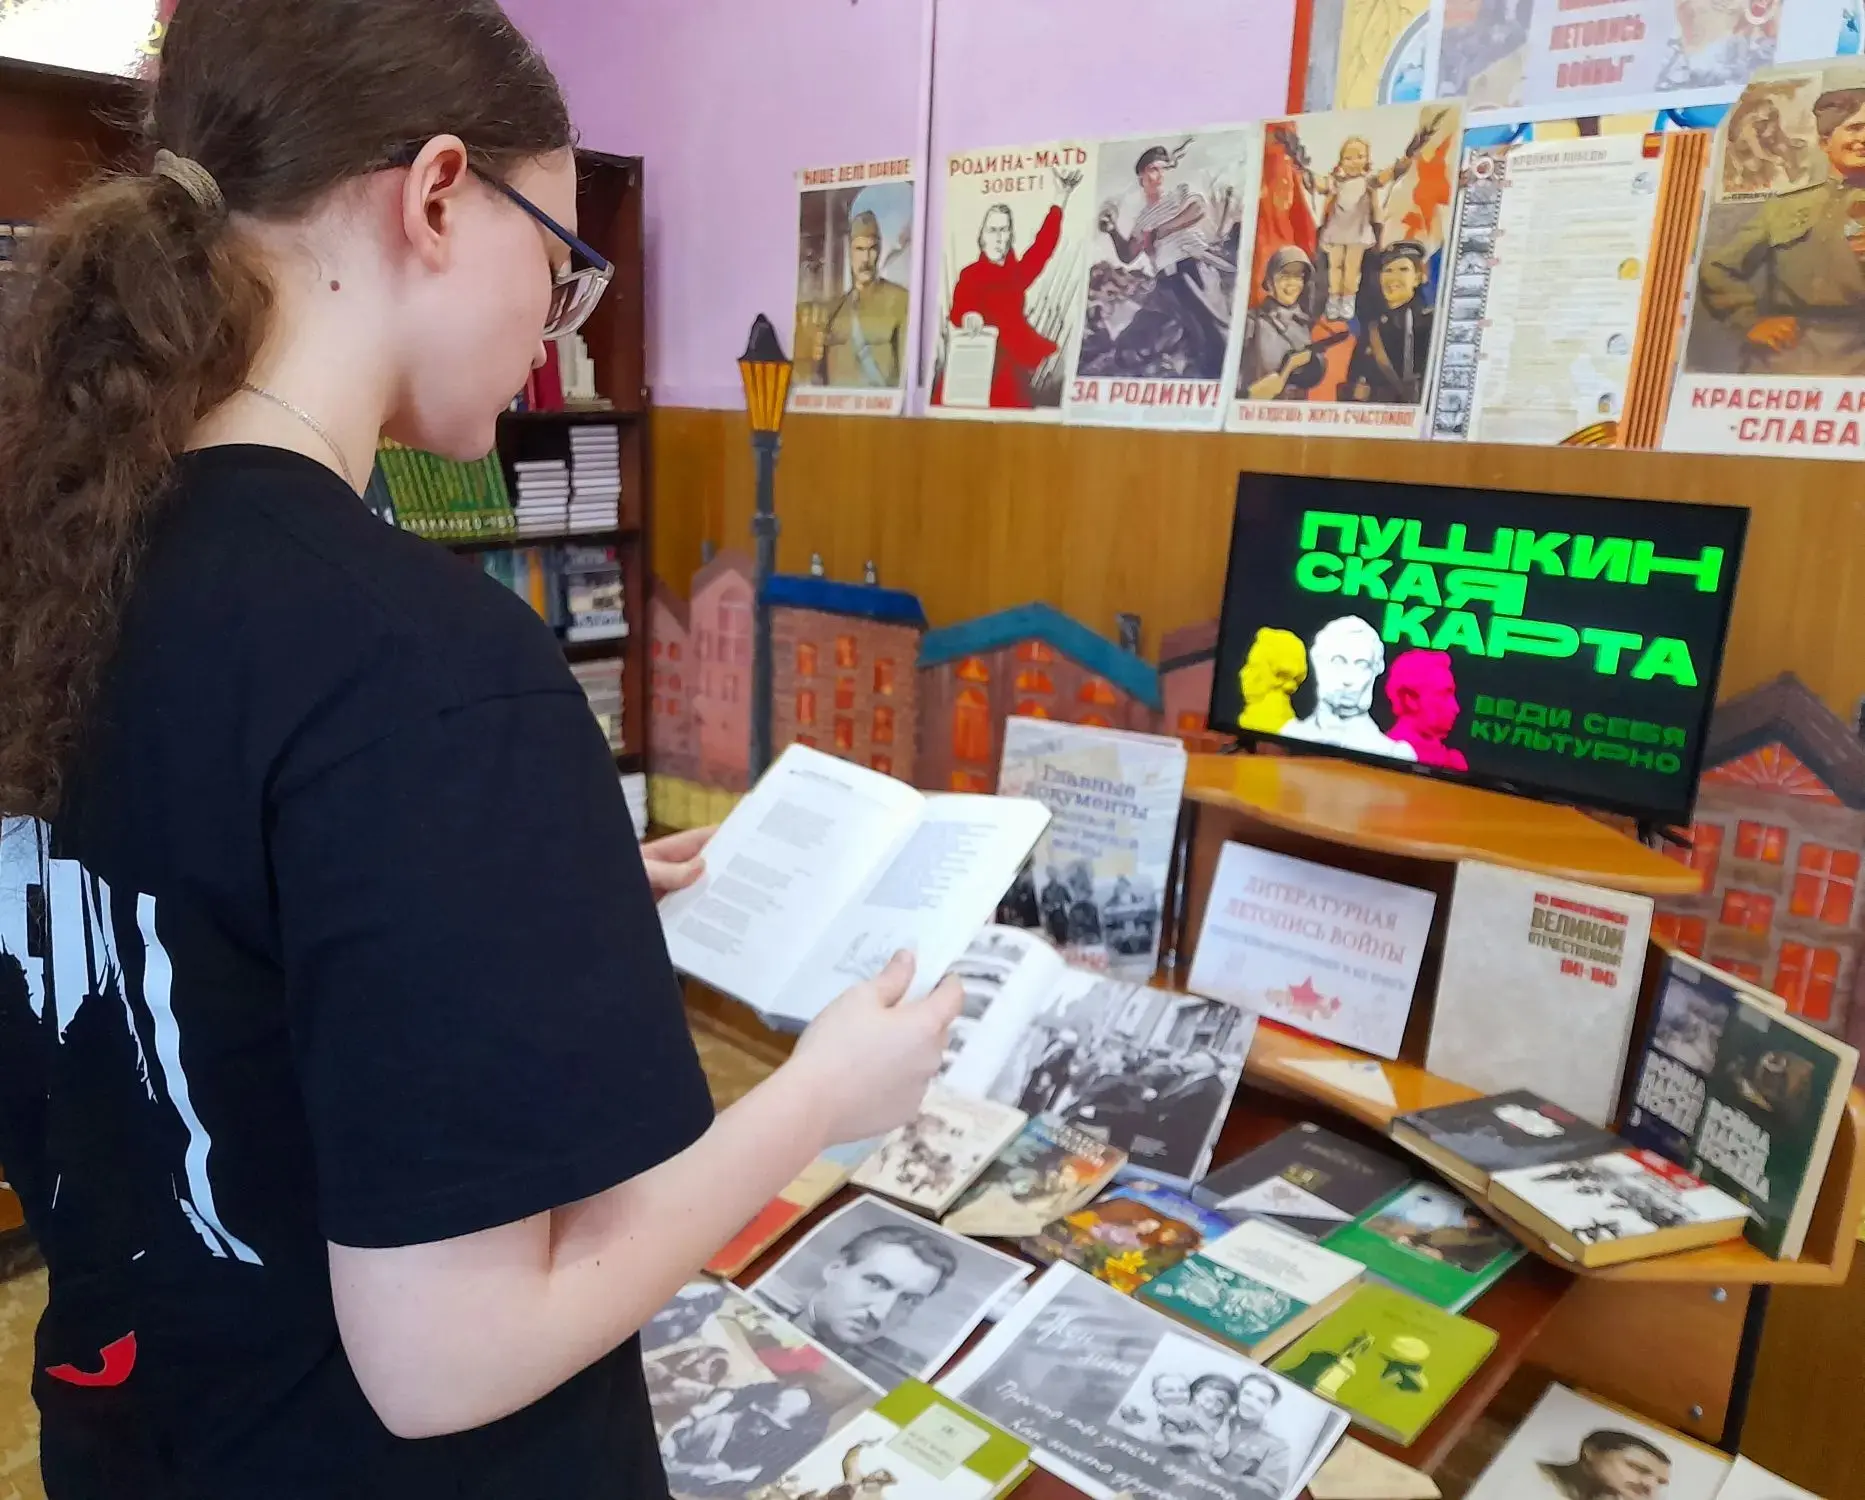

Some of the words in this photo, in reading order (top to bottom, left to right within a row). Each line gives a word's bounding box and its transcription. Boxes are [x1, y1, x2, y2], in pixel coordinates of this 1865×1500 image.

[949, 147, 1087, 176] РОДИНА-МАТЬ
[981, 175, 1044, 195] ЗОВЕТ!
[1071, 381, 1099, 402] ЗА
[1110, 382, 1221, 408] РОДИНУ!
[1692, 387, 1823, 411] КРАСНОЙ
[1300, 510, 1724, 592] ПУШКИН
[1296, 552, 1528, 616] СКАЯ
[1382, 603, 1698, 686] КАРТА
[1470, 720, 1681, 774] КУЛЬТУРНО
[1475, 695, 1573, 728] ВЕДИ
[1583, 712, 1687, 748] СЕБЯ
[1243, 876, 1398, 931] ЛИТЕРАТУРНАЯ
[1223, 898, 1325, 942] ЛЕТОПИСЬ
[1329, 926, 1407, 965] ВОЙНЫ
